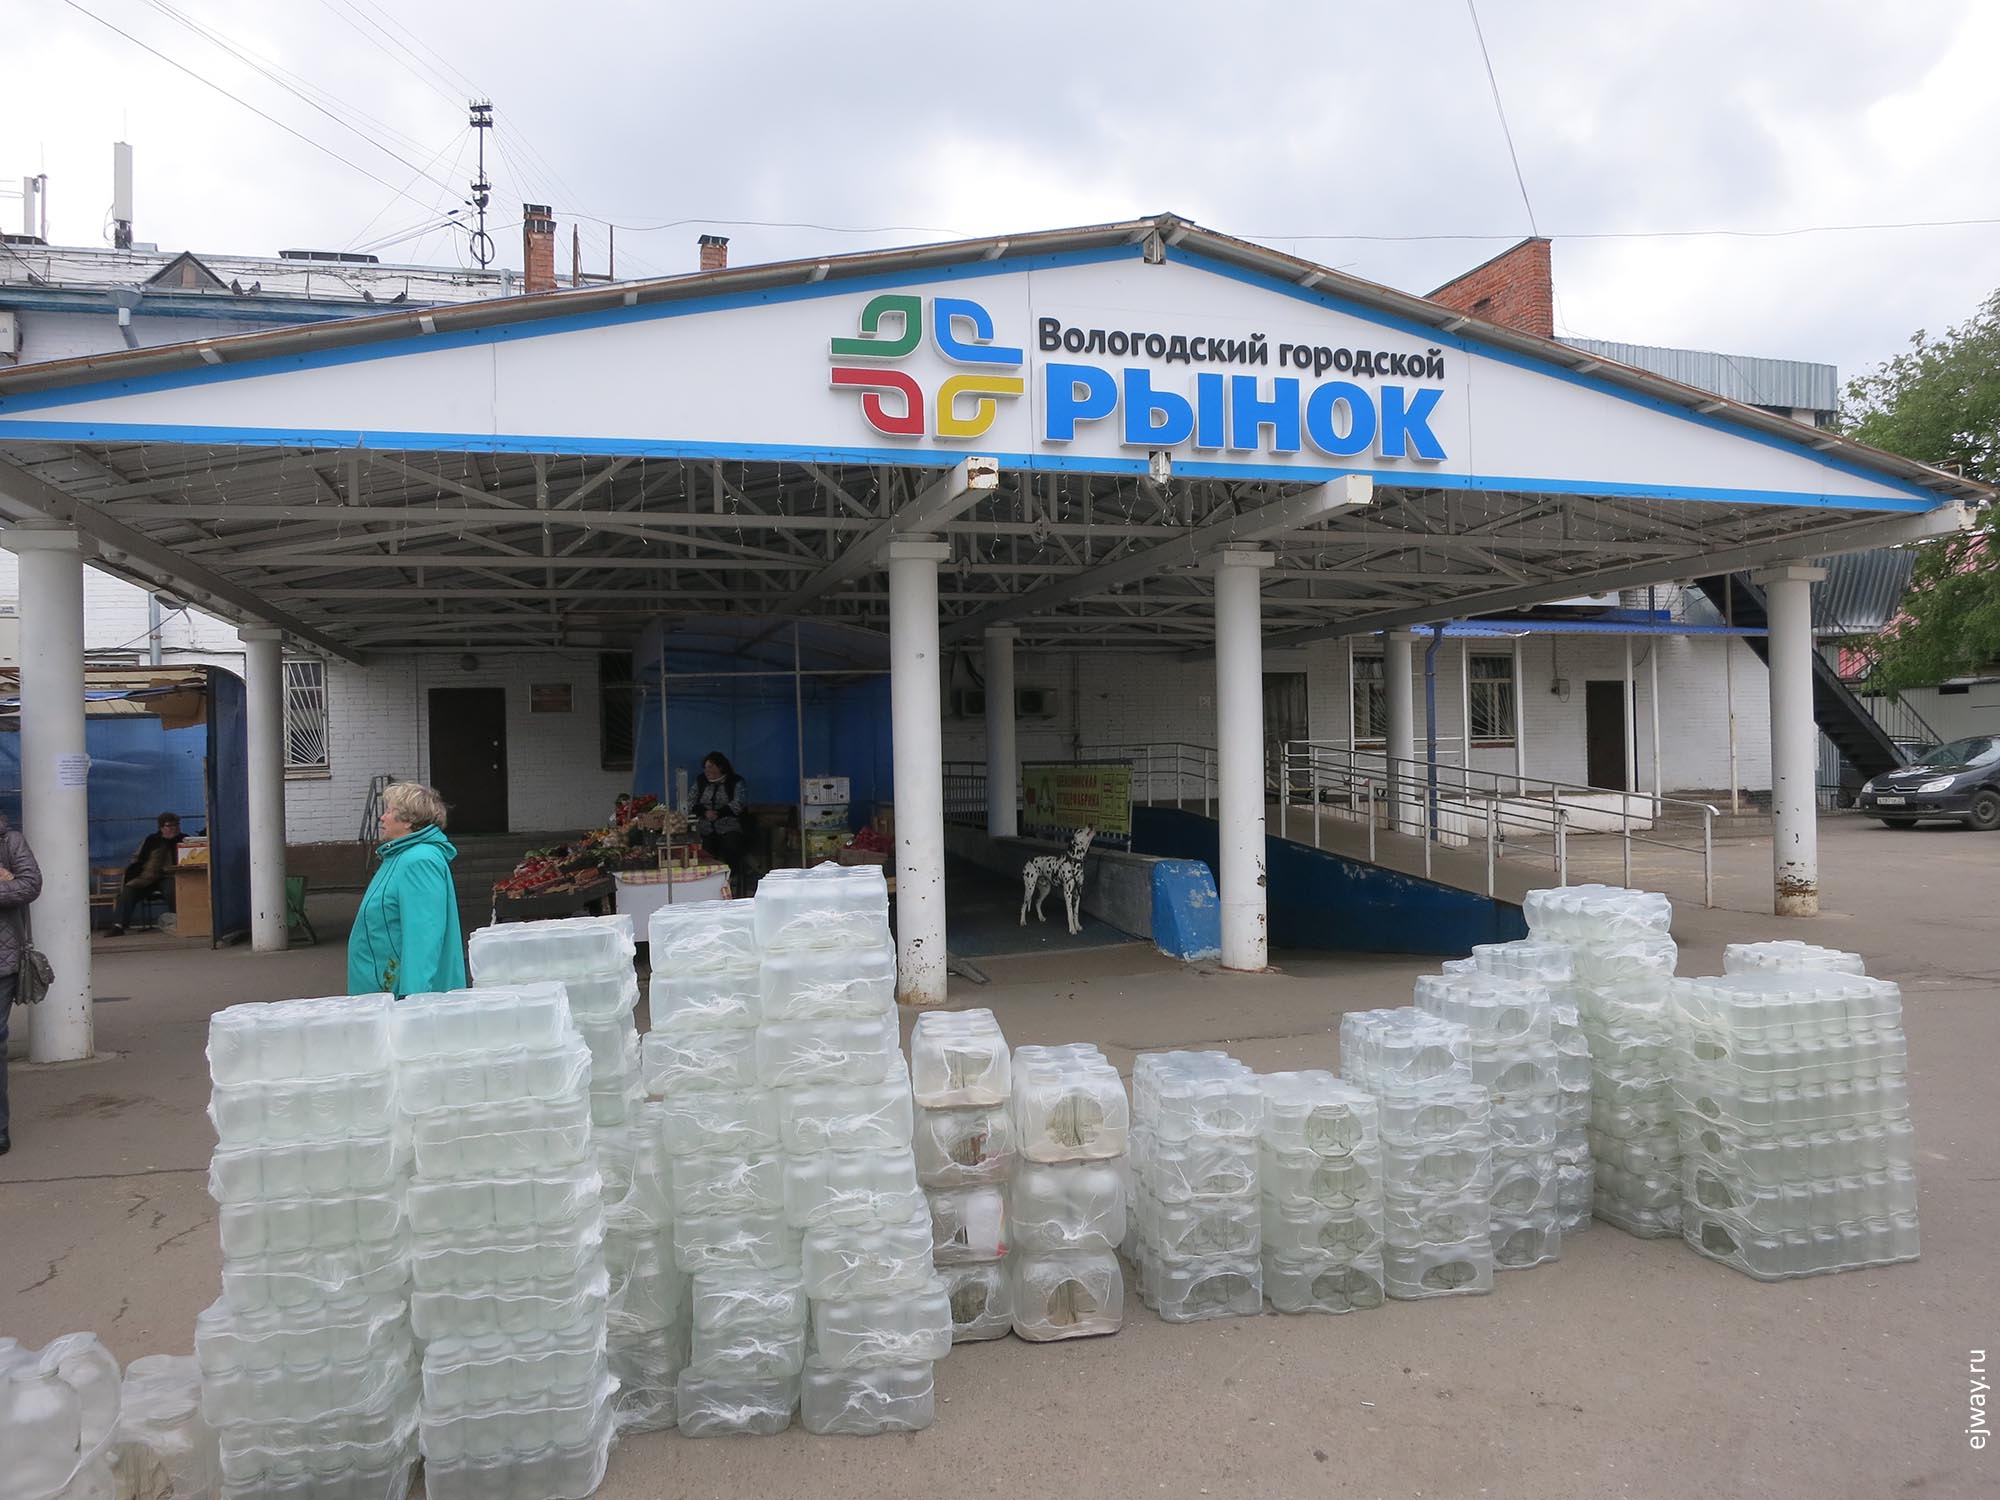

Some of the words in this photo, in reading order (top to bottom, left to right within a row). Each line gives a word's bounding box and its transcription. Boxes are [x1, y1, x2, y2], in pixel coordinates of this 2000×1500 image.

[1039, 317, 1267, 365] Вологодский
[1280, 344, 1444, 379] городской
[1045, 363, 1447, 462] РЫНОК
